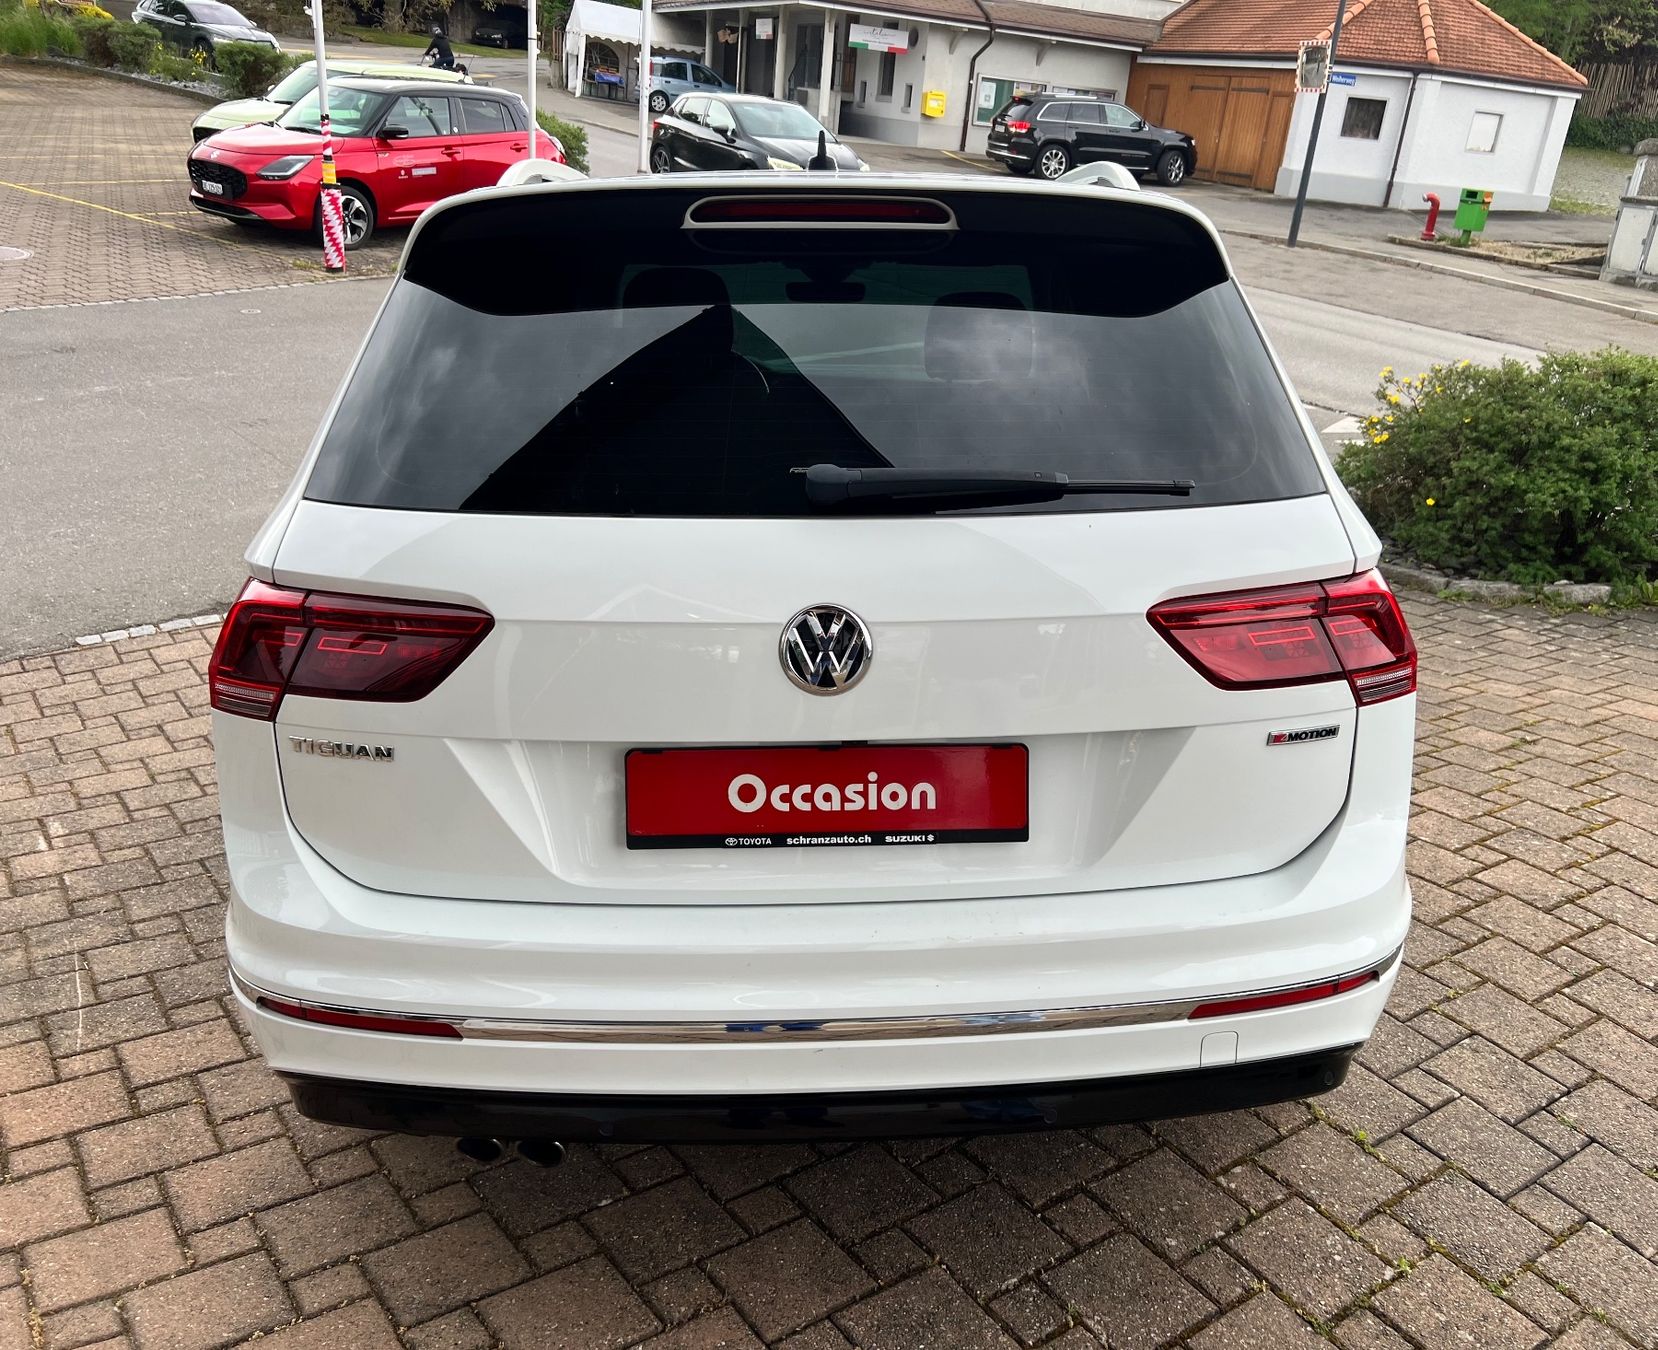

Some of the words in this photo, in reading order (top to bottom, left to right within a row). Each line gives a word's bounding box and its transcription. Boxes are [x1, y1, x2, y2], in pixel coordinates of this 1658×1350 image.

[289, 735, 394, 762] TIGUAN
[728, 771, 937, 812] Occasion
[739, 837, 772, 846] TOYOTA
[786, 834, 872, 845] schranzauto.ch
[885, 835, 926, 843] SUZUKI
